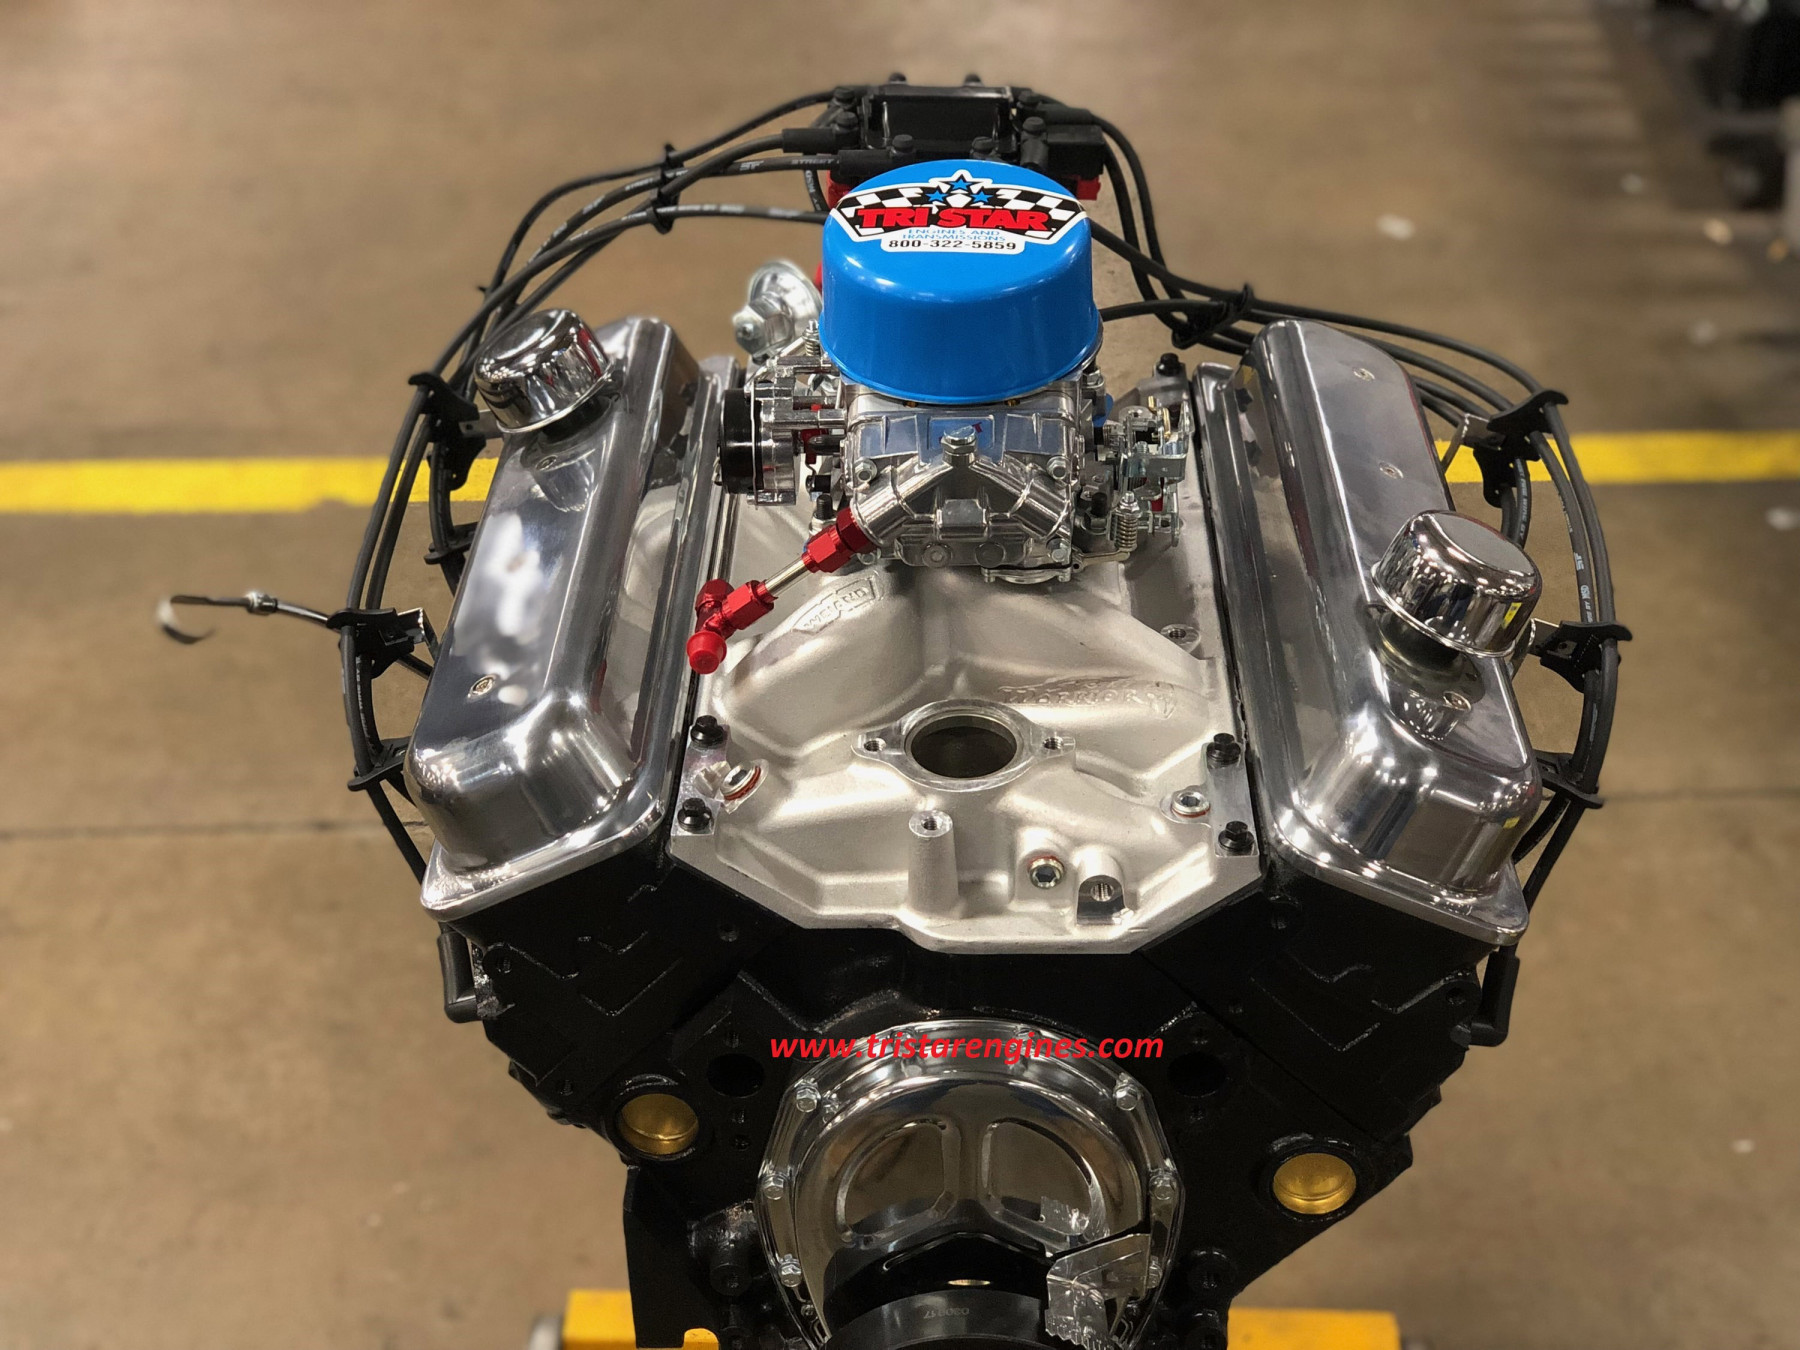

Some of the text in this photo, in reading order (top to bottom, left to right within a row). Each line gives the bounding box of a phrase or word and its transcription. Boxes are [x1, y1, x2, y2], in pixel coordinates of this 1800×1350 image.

[857, 207, 1050, 231] TRI STAR
[888, 239, 1017, 250] 800-322-5859
